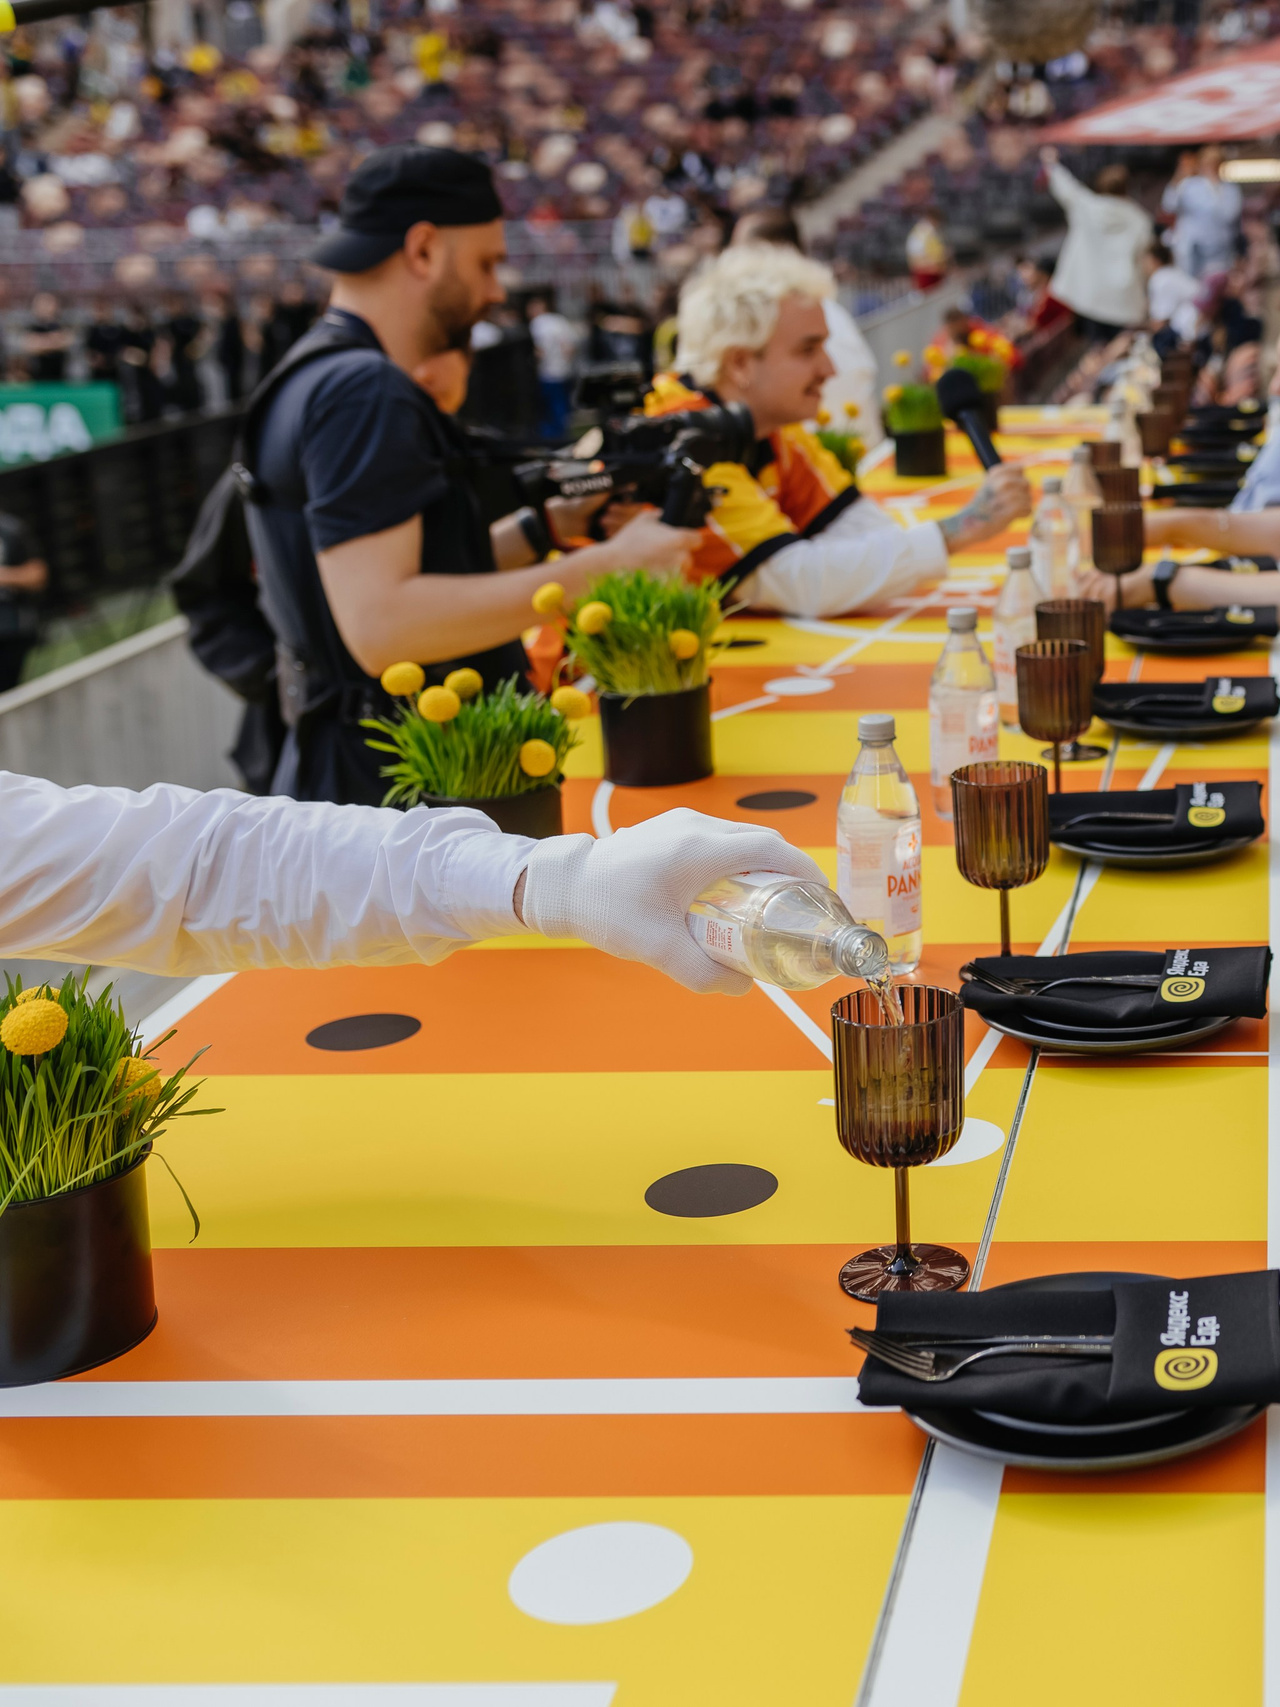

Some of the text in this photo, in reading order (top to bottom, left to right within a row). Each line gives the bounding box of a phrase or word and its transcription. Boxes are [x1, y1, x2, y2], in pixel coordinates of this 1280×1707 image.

[1166, 949, 1190, 976] Яндек
[1187, 961, 1210, 977] Еда
[1160, 1290, 1191, 1347] Яндекс
[1190, 1315, 1220, 1346] Еда
